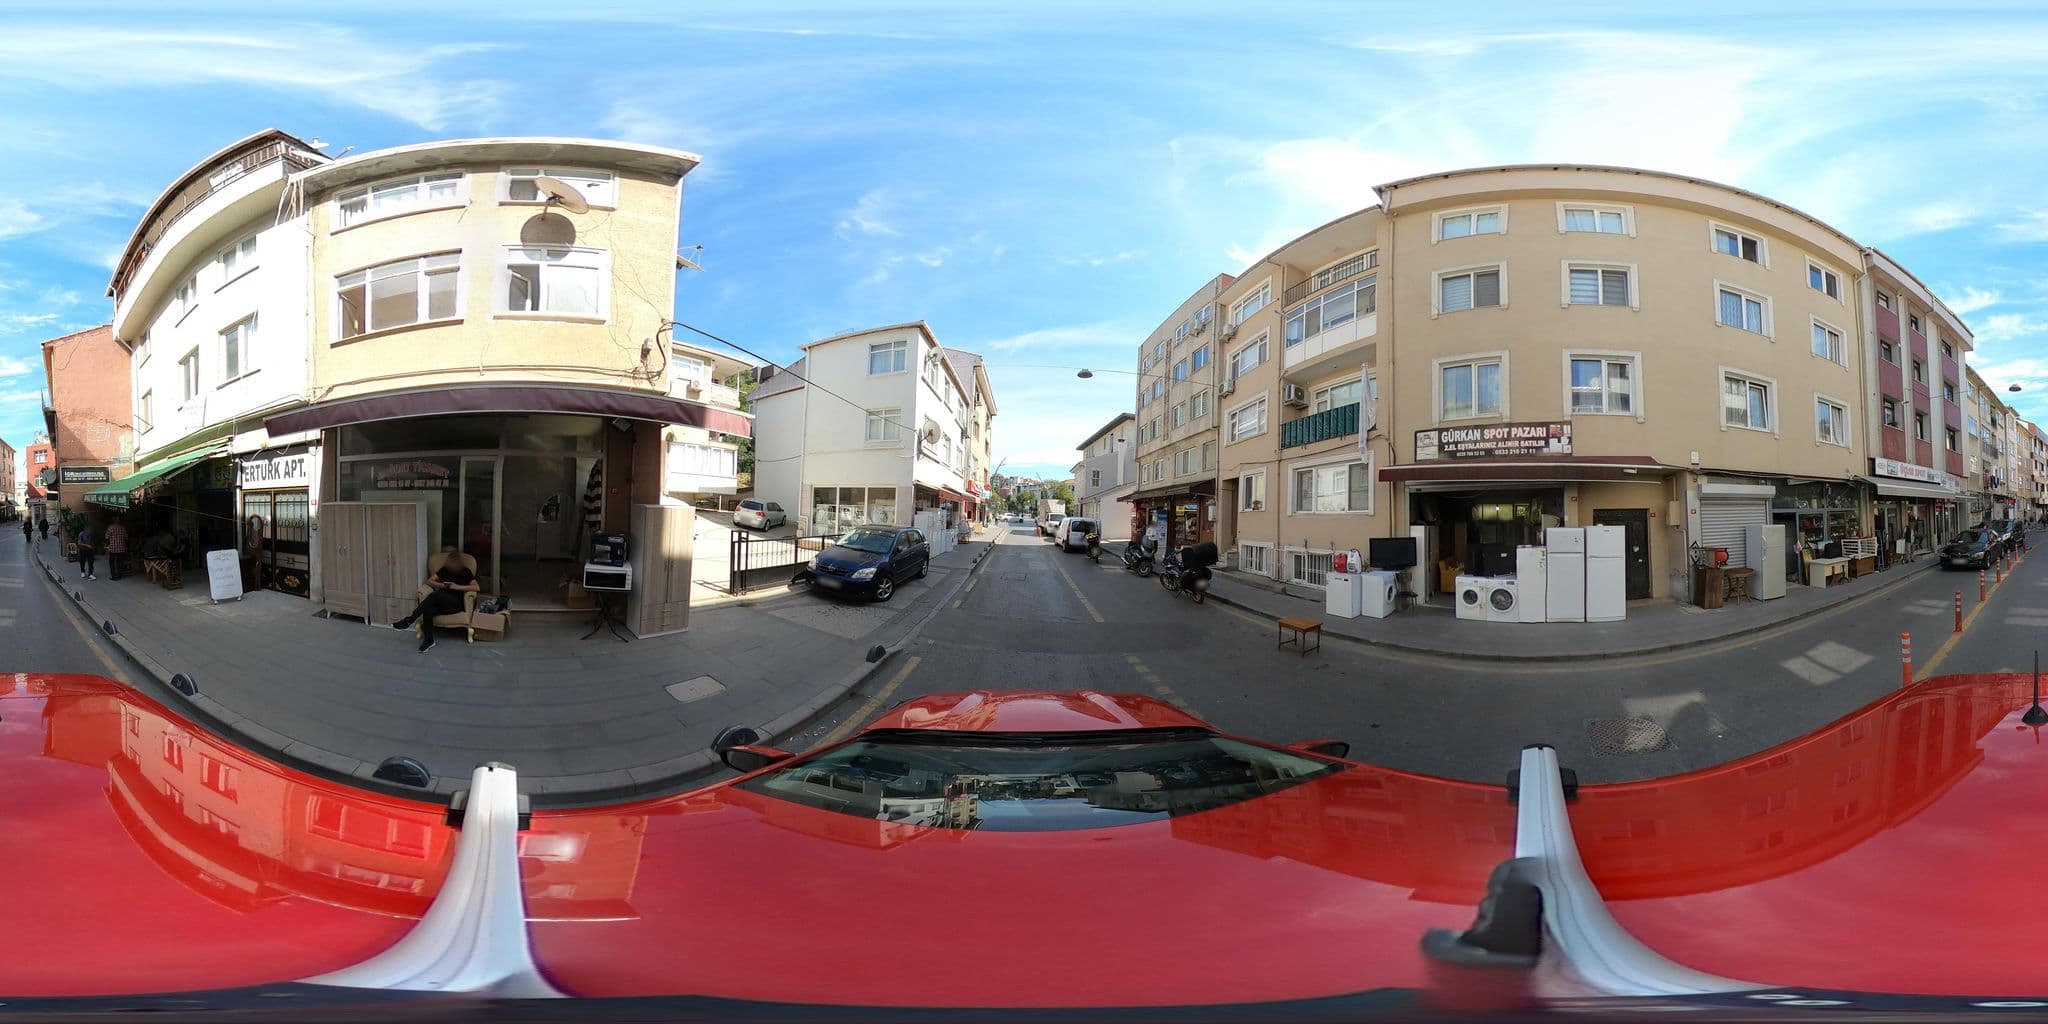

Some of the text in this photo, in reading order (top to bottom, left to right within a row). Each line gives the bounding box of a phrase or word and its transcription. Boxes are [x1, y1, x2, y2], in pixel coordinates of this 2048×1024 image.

[1441, 427, 1546, 443] GÜRKAN SPOT PAZARI
[284, 458, 306, 479] APT.
